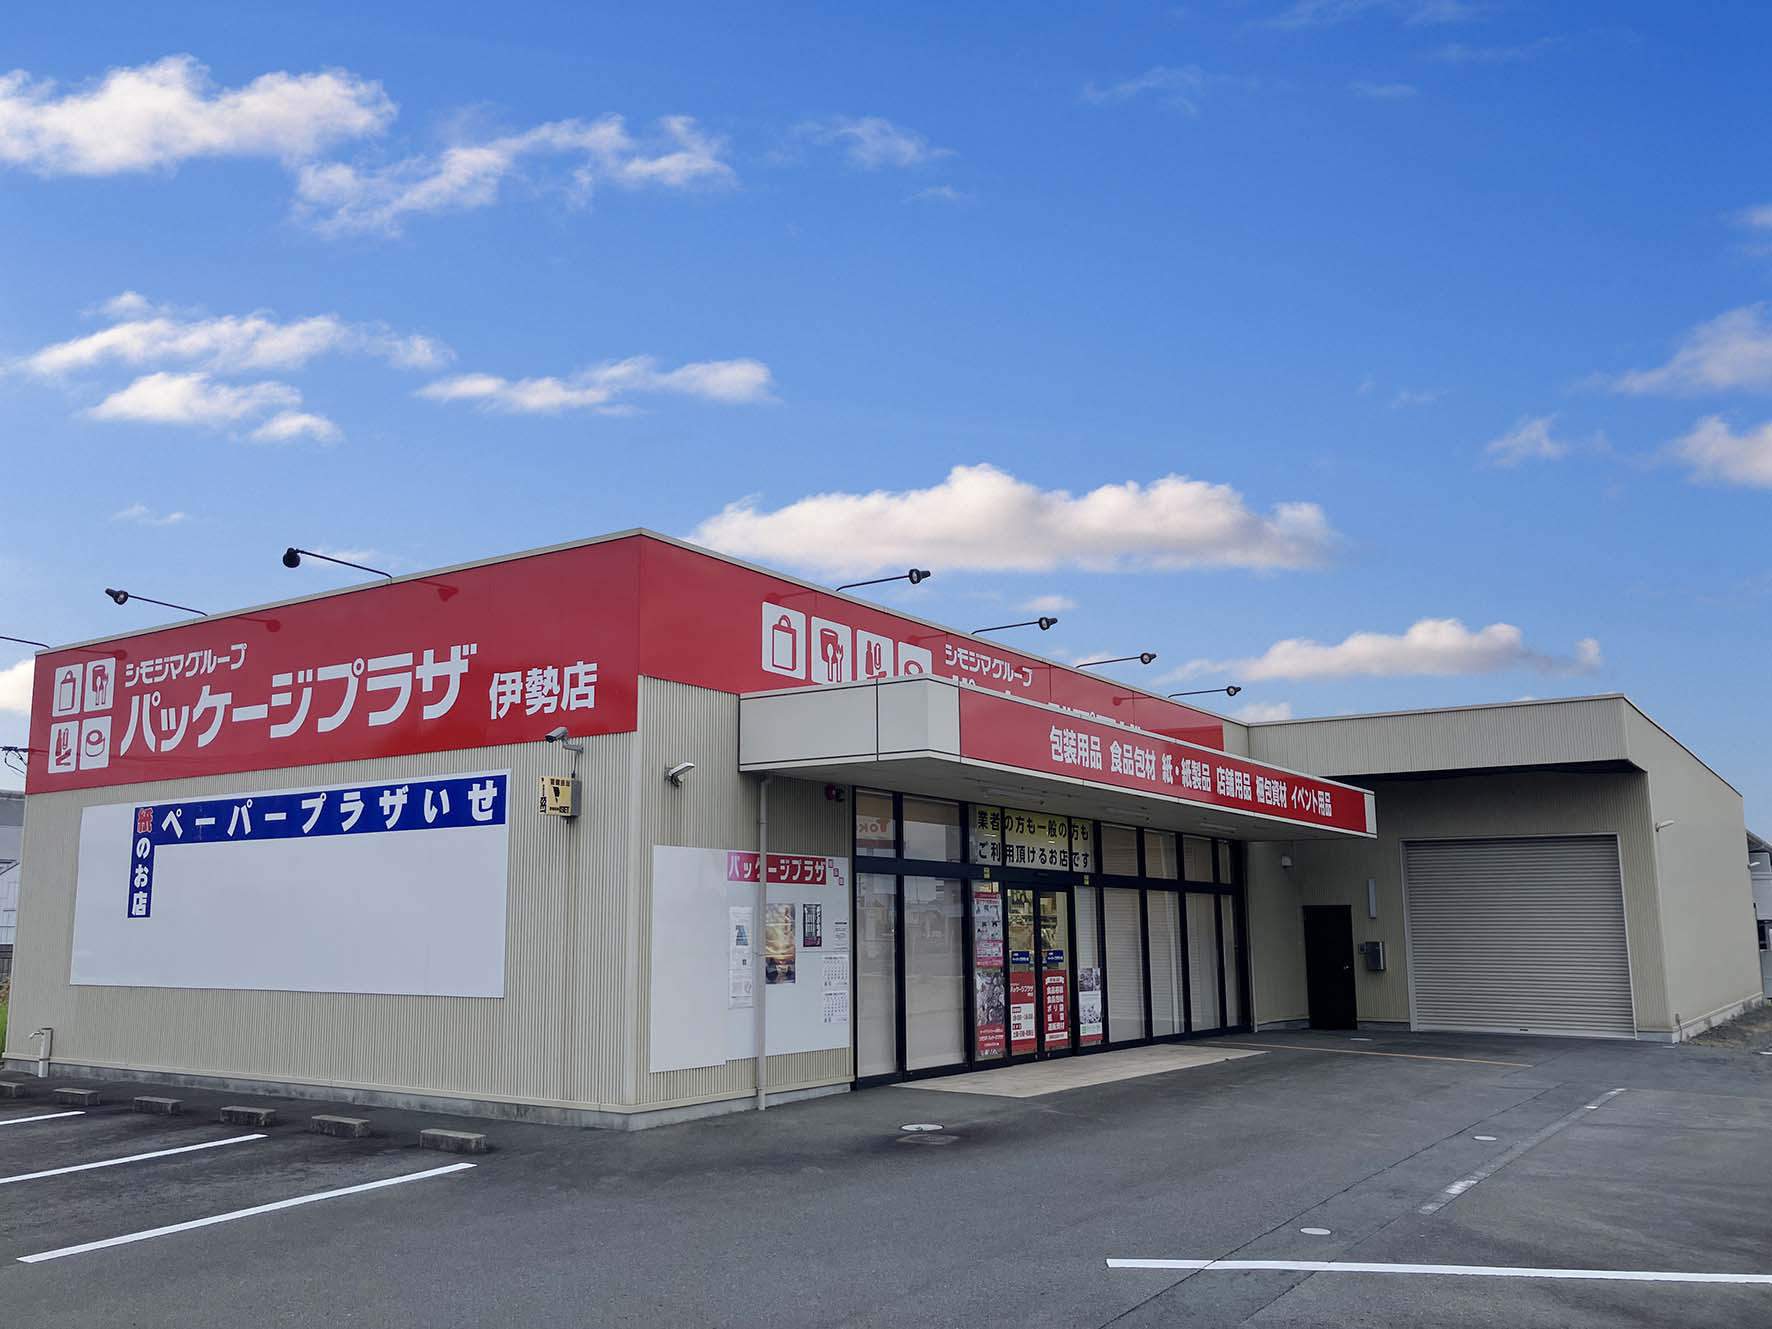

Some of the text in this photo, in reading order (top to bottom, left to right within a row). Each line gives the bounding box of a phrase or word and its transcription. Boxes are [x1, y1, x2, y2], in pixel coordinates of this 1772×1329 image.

[124, 642, 248, 686] シモジマグループ
[489, 661, 598, 720] 伊勢店
[944, 643, 1033, 687] シモジマグループ
[120, 643, 478, 755] パッケージプラザ
[1050, 725, 1102, 771] 包装用品
[1110, 740, 1156, 782] 食品包材
[1162, 753, 1211, 793] 紙・紙製品
[1291, 785, 1333, 817] イベント用品
[161, 780, 498, 838] ペーパープラザいせ
[977, 811, 1089, 840] 業者の方も一般の方も
[131, 807, 154, 916] 紙のお店
[978, 841, 1090, 868] ご利用頂けるお店です
